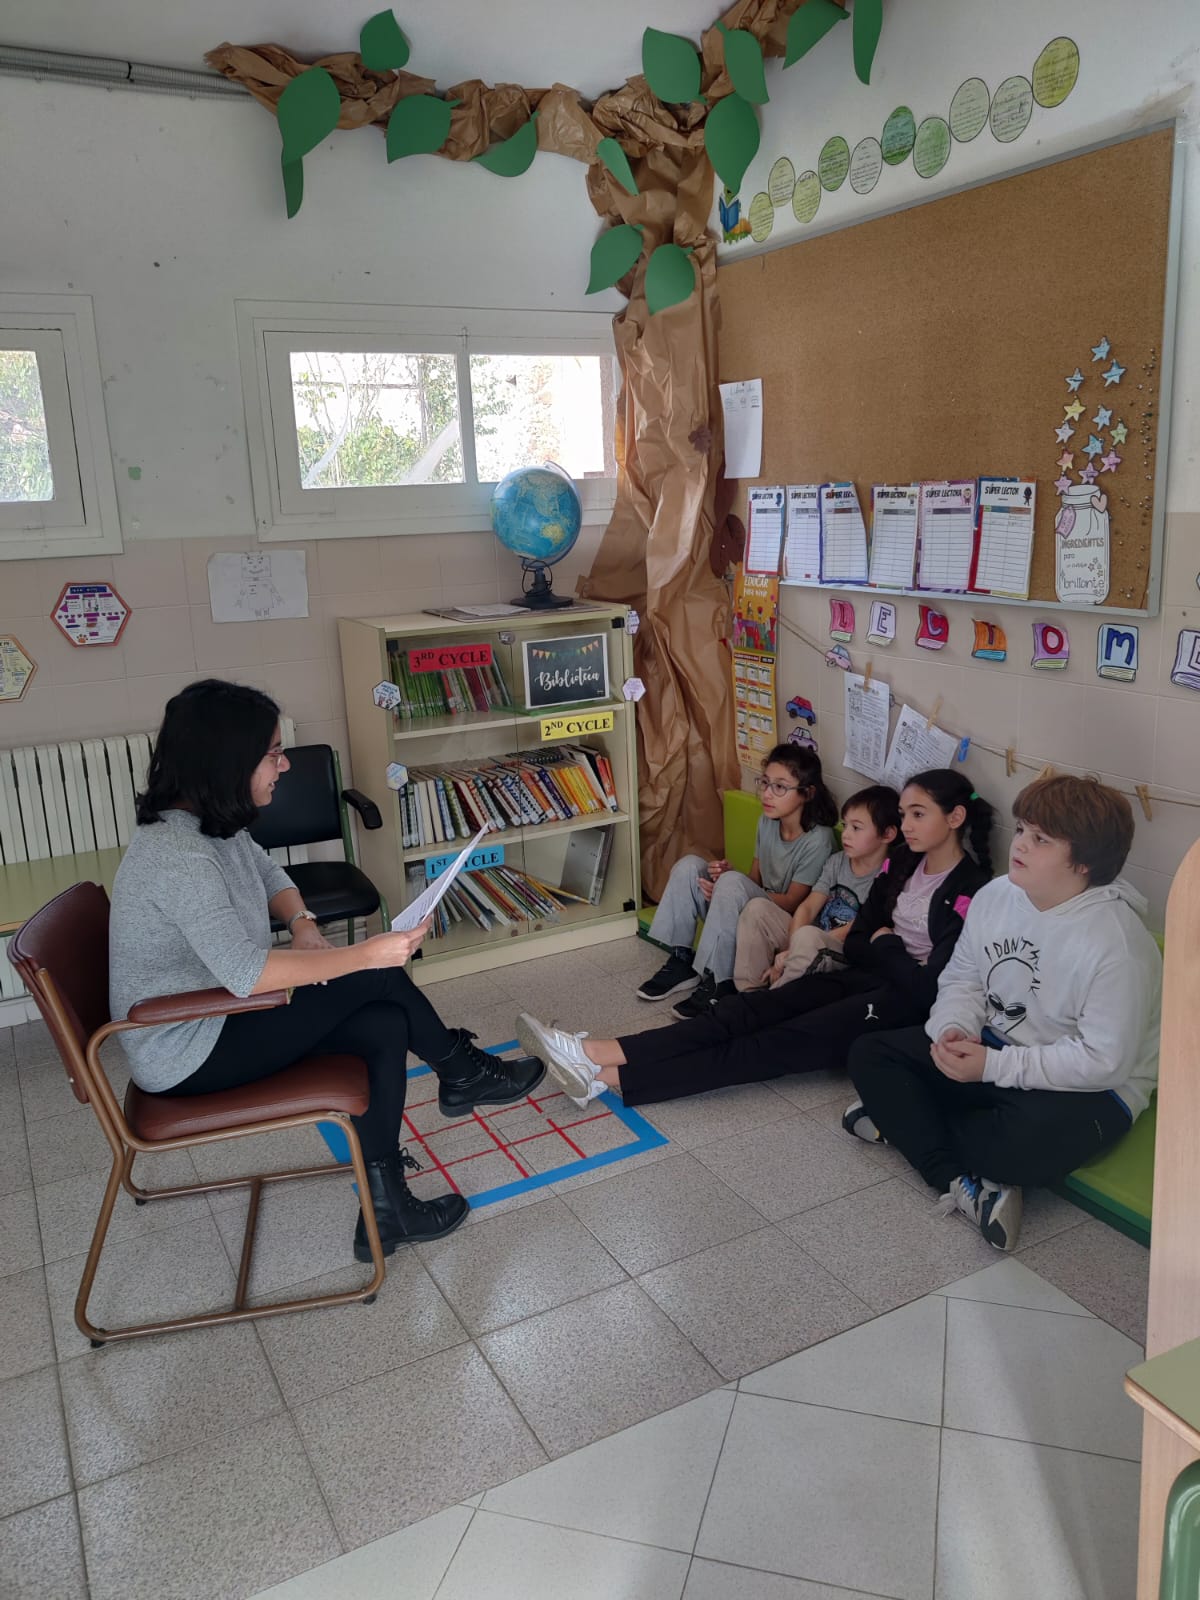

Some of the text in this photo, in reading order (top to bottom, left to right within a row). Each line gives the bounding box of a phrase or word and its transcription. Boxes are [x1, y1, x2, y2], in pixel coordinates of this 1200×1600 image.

[438, 650, 489, 666] CYCLE
[534, 666, 600, 691] Biblioteca
[566, 718, 611, 734] CYCLE
